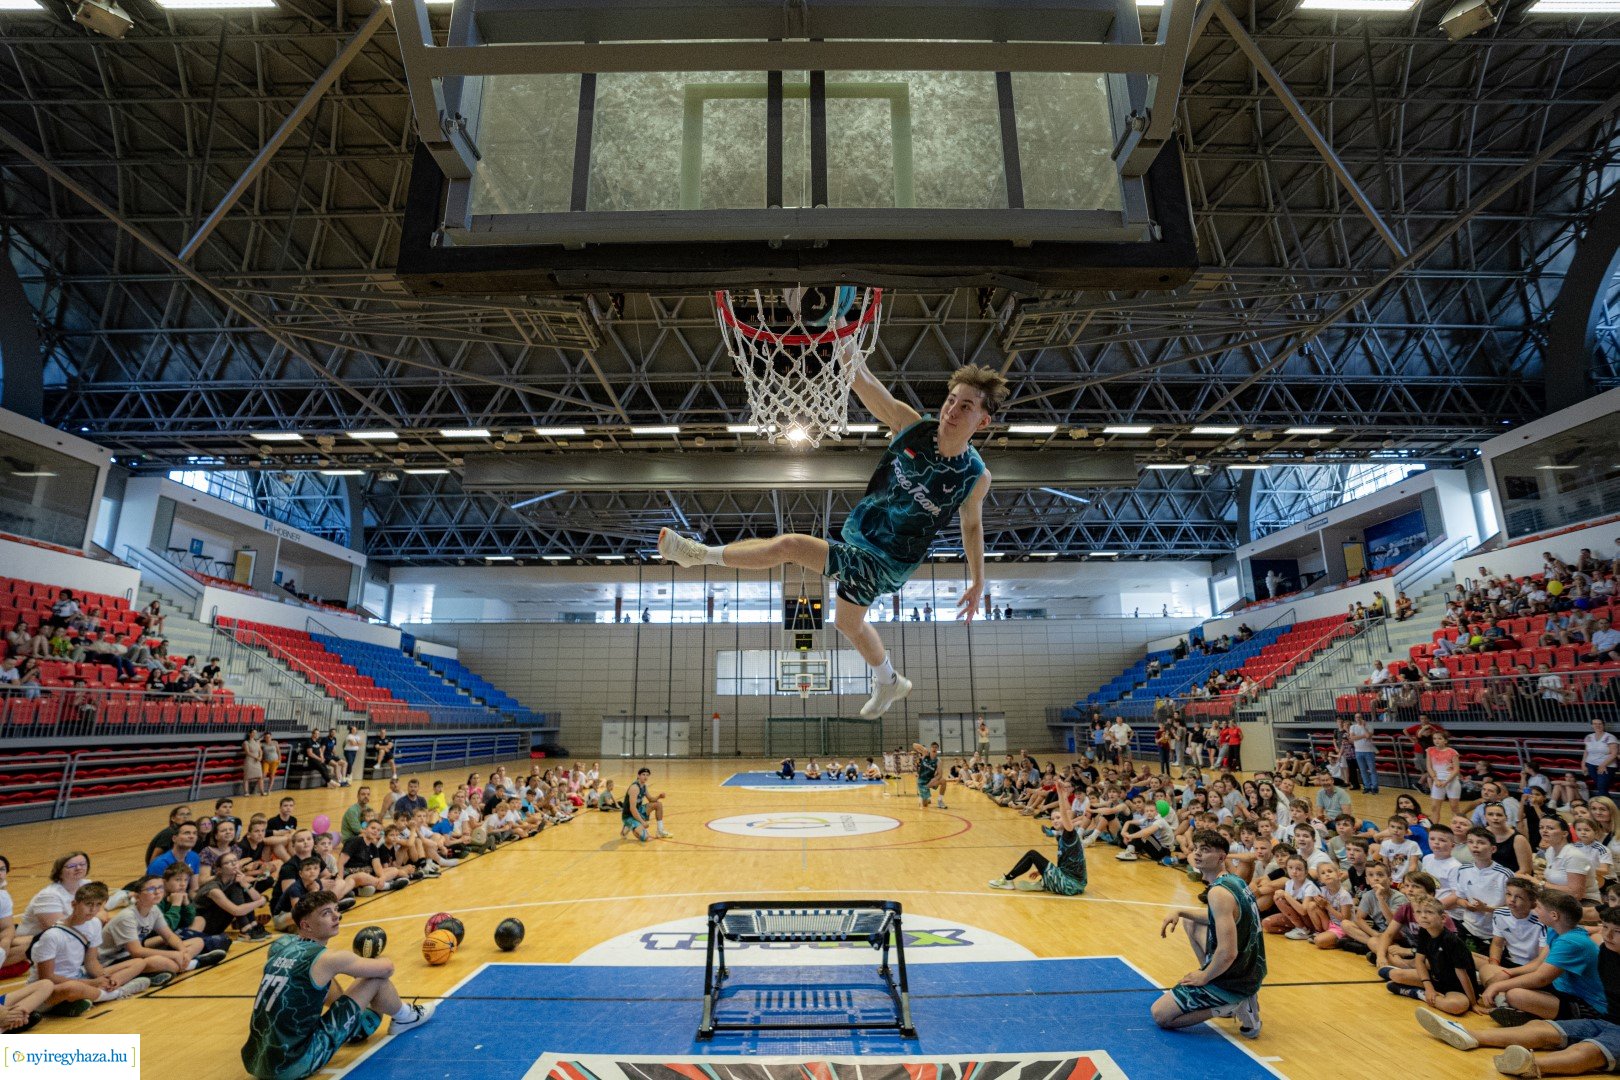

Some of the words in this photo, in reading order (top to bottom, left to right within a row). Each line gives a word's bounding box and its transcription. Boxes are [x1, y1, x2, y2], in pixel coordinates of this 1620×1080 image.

[891, 456, 912, 490] Face
[908, 483, 941, 517] Team
[254, 973, 289, 1012] 77
